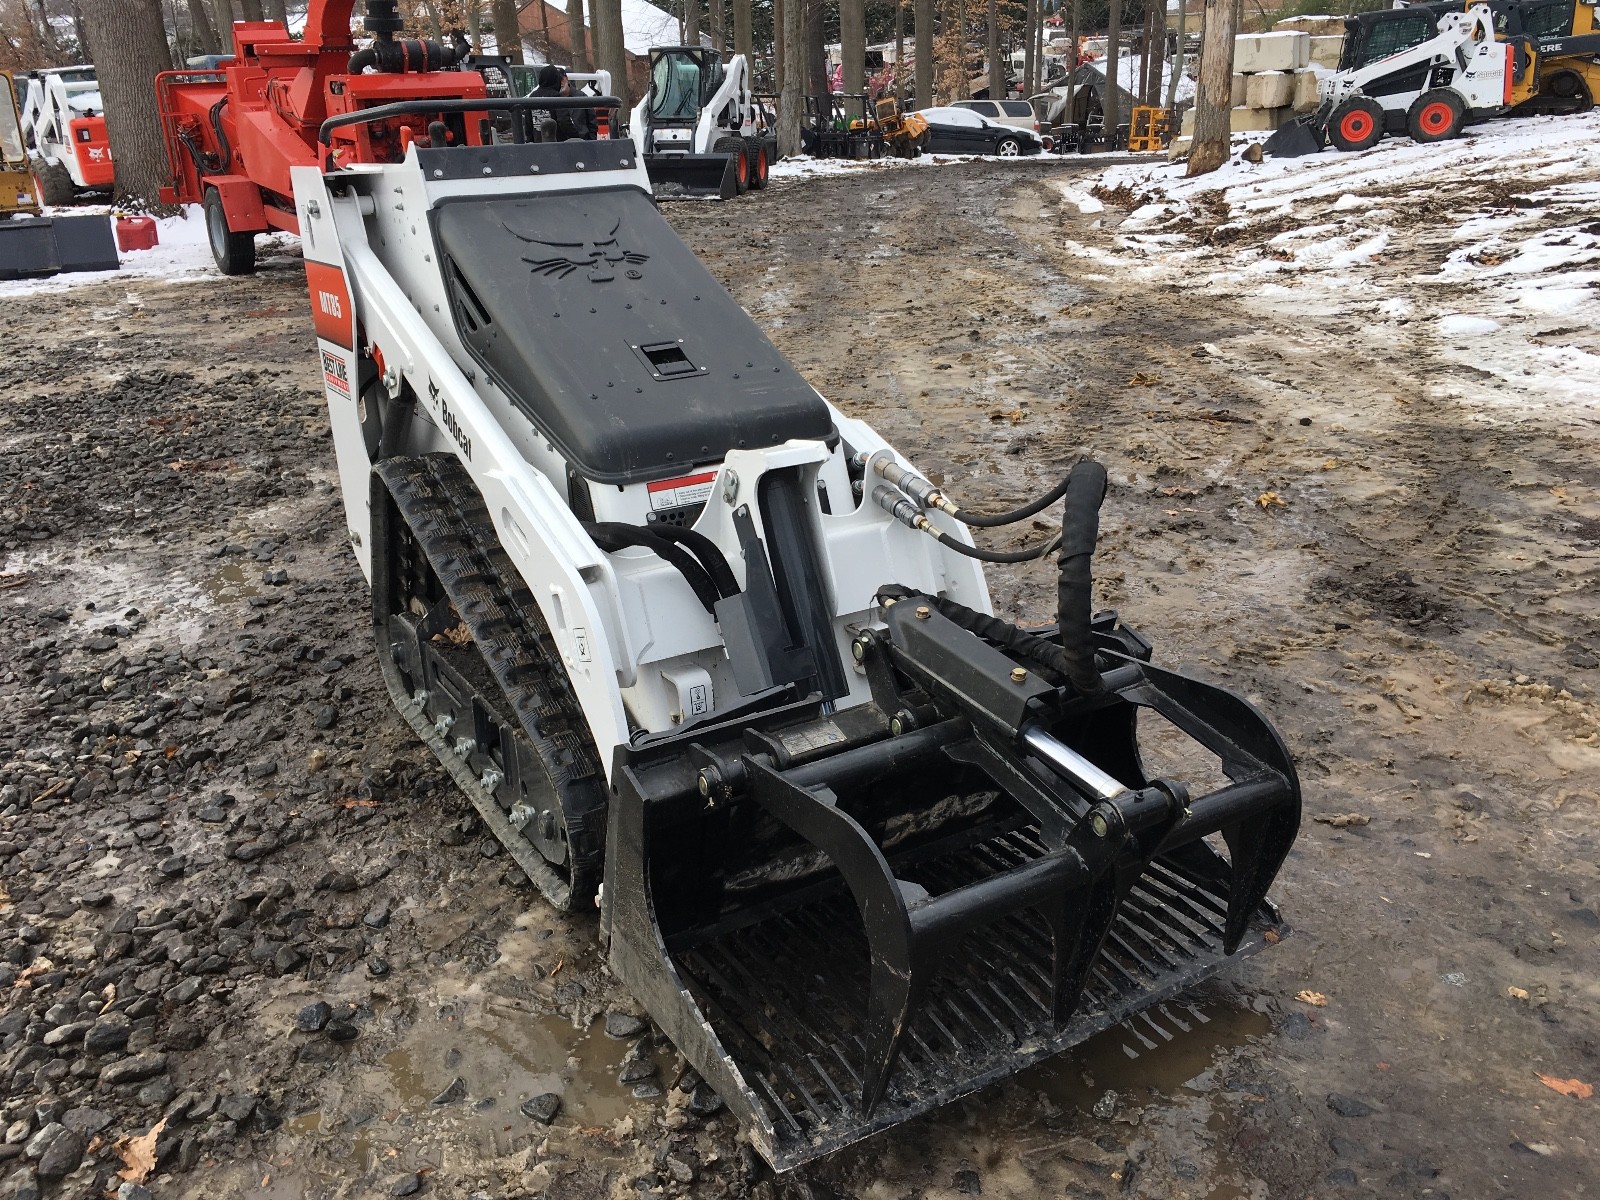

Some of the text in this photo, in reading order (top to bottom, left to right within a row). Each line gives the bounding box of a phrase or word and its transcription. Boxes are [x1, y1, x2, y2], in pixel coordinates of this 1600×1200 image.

[1540, 43, 1563, 53] ERE
[319, 290, 342, 319] MT85
[442, 398, 472, 462] Bobcat
